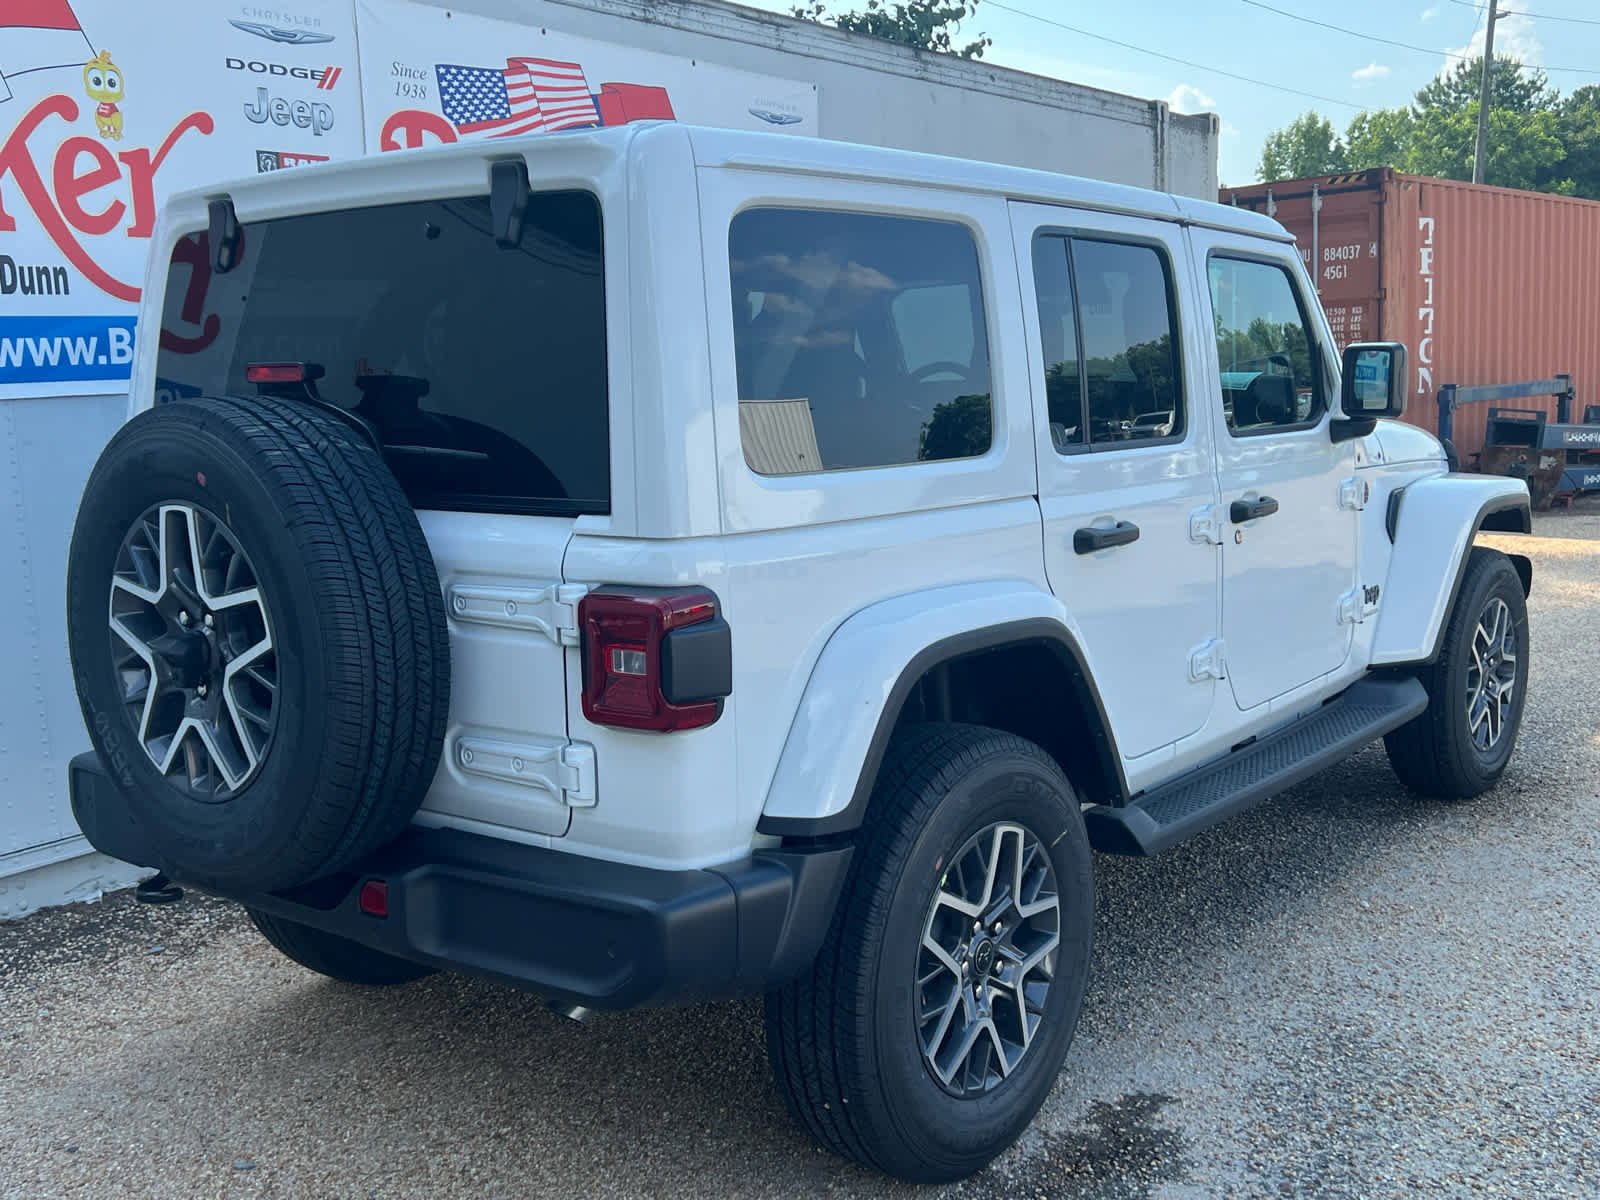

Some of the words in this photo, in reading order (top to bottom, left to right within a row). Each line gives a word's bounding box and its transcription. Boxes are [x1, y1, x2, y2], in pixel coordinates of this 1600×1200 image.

[241, 7, 321, 27] CHRYSLER
[225, 57, 327, 81] DODGE
[392, 60, 428, 80] Since
[395, 81, 427, 100] 1938
[243, 86, 335, 136] Jeep
[1324, 244, 1361, 261] 884037
[0, 254, 70, 296] Dunn
[1323, 264, 1347, 280] 45G1
[0, 326, 138, 368] www.B
